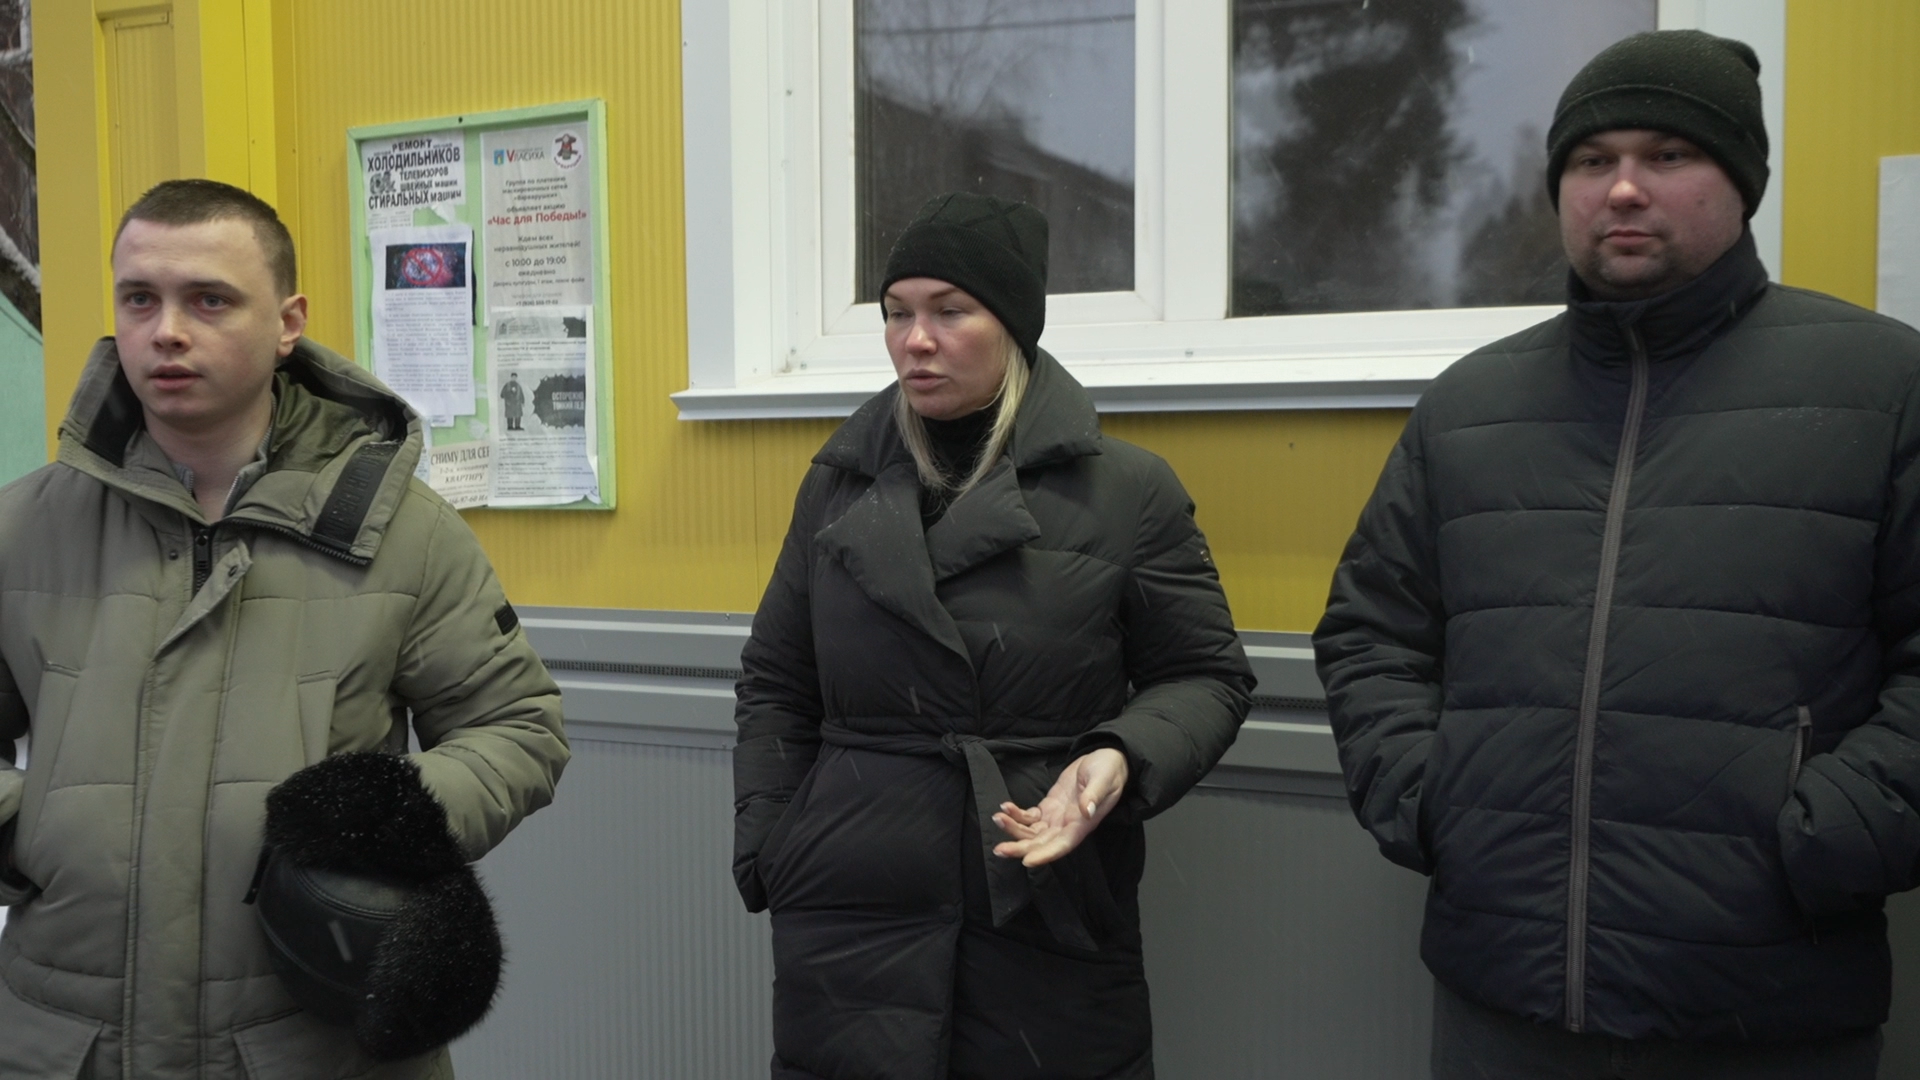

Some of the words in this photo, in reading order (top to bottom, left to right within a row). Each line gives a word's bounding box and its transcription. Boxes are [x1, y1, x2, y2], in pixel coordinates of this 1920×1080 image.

[392, 139, 432, 152] РЕМОНТ
[368, 147, 460, 172] ХОЛОДИЛЬНИКОВ
[400, 166, 448, 181] ТЕЛЕВИЗОРОВ
[400, 180, 433, 192] ШВЕЙНЫХ
[435, 179, 458, 188] машин
[369, 190, 429, 210] СТИРАЛЬНЫХ
[430, 190, 461, 202] машин
[488, 215, 511, 225] «Час
[513, 215, 532, 225] для
[536, 209, 587, 223] Победы!»
[533, 258, 544, 266] до
[430, 450, 458, 465] СНИМУ
[460, 448, 477, 463] ДЛЯ
[445, 472, 484, 484] КВАРТИРУ
